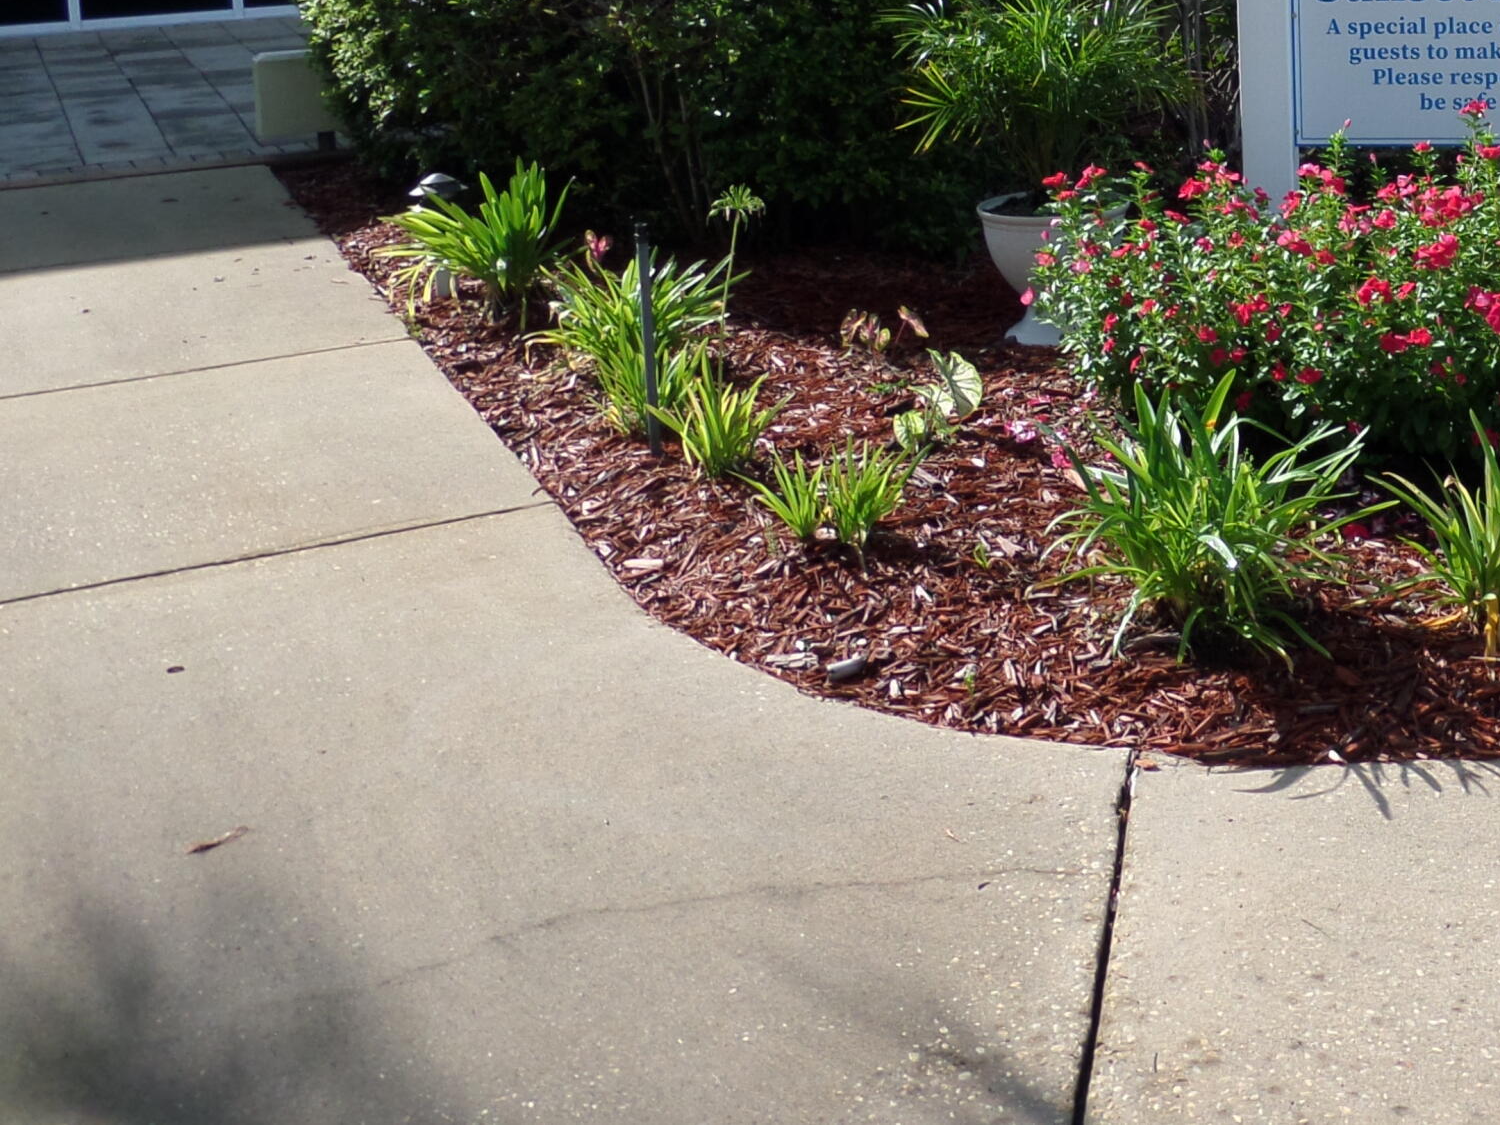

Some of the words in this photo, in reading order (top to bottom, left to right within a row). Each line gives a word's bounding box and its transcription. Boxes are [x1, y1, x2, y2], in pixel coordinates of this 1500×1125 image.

[1325, 18, 1342, 35] A
[1347, 15, 1427, 38] special
[1433, 16, 1494, 38] place
[1348, 43, 1421, 66] guests
[1426, 43, 1449, 60] to
[1372, 67, 1444, 86] Please
[1419, 92, 1447, 111] be
